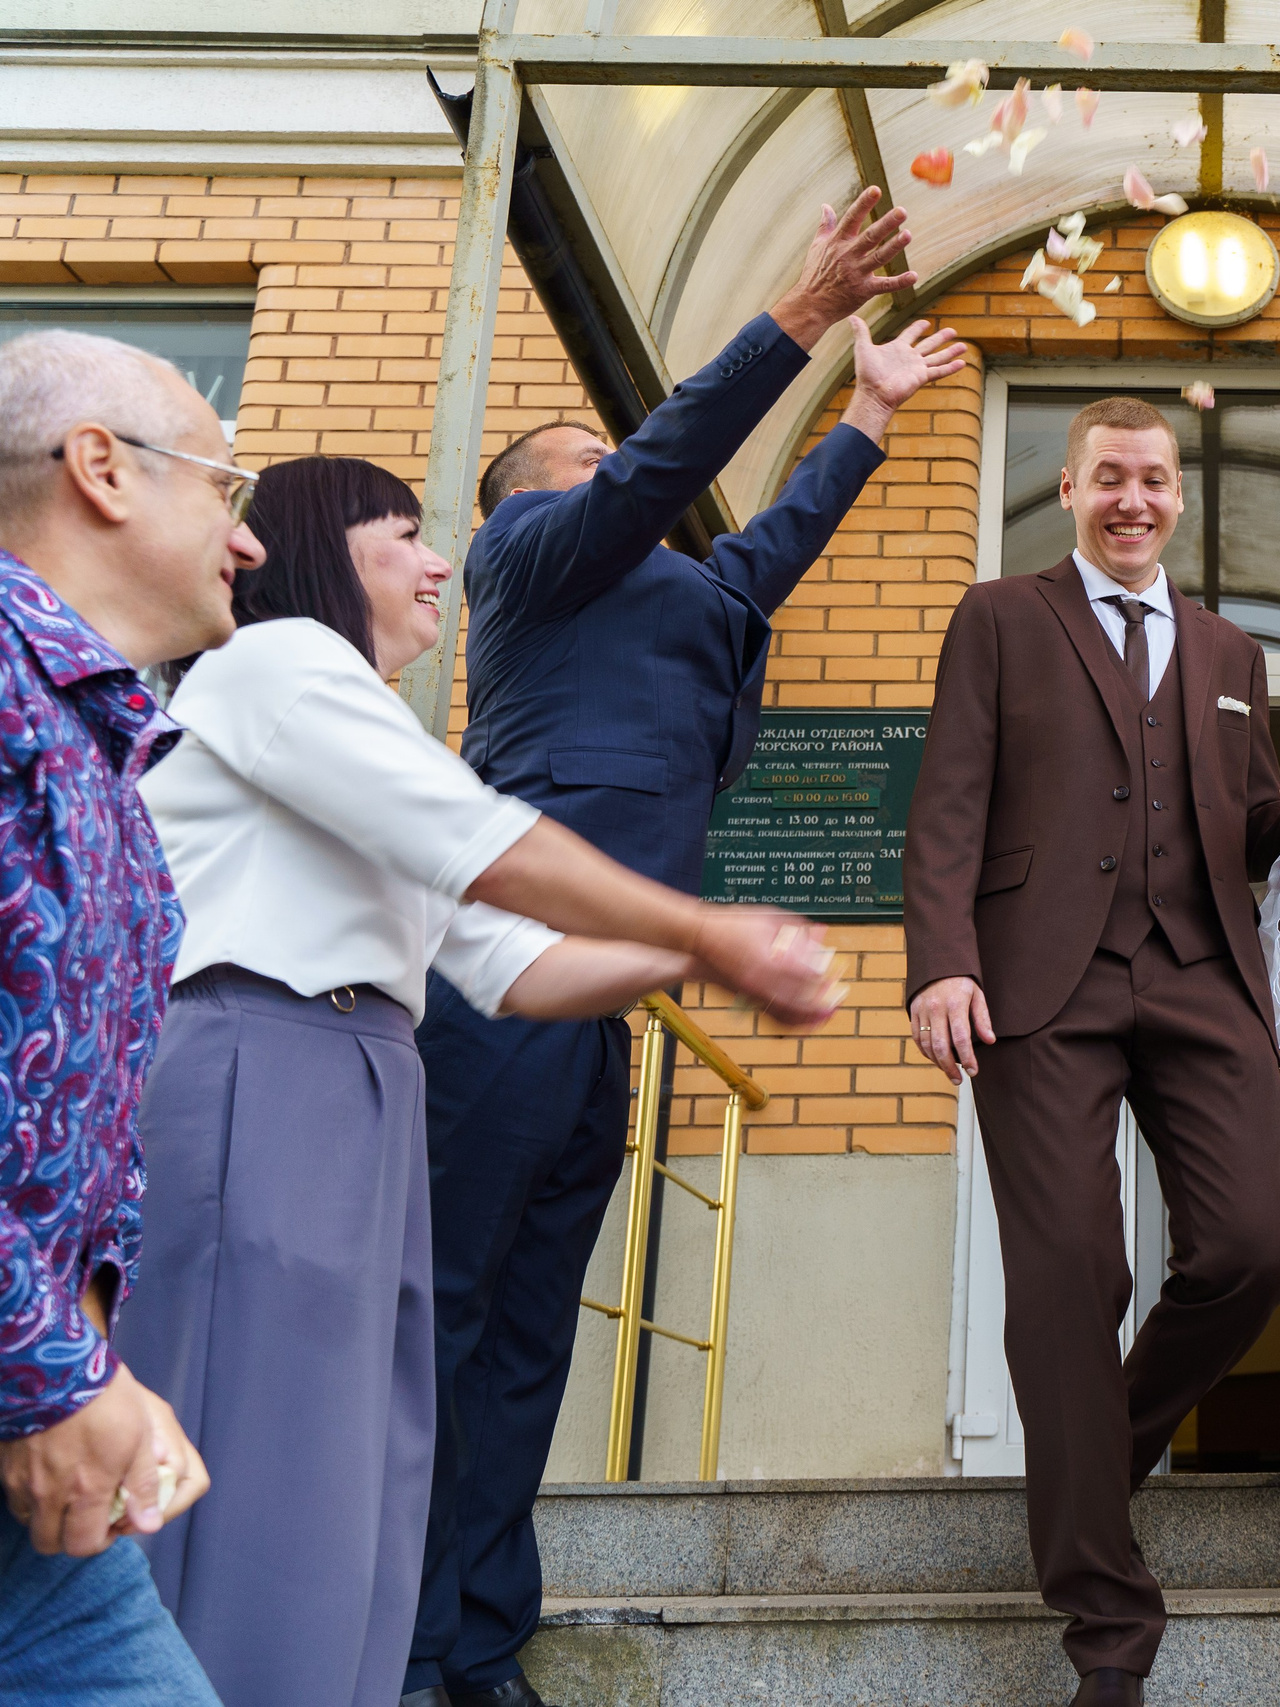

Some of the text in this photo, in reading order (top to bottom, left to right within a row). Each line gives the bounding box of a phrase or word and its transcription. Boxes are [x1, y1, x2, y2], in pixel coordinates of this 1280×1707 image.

[810, 728, 874, 740] ОТДЕЛОМ
[882, 726, 926, 738] ЗАГС
[832, 740, 884, 751] РАЙОНА
[728, 818, 770, 826] ПЕРЕРЫВ
[789, 815, 819, 826] 13.00
[844, 815, 875, 825] 14.00
[831, 829, 882, 838] ВЫХОДНОЙ
[720, 852, 766, 860] ГРАЖДАН
[724, 864, 766, 872] ВТОРНИК
[784, 862, 815, 872] 14.00
[841, 862, 872, 872] 17.00
[724, 878, 765, 886] ЧЕТВЕРГ
[784, 875, 815, 885] 10.00
[840, 875, 872, 885] 13.00
[814, 894, 850, 903] РАБОЧИЙ
